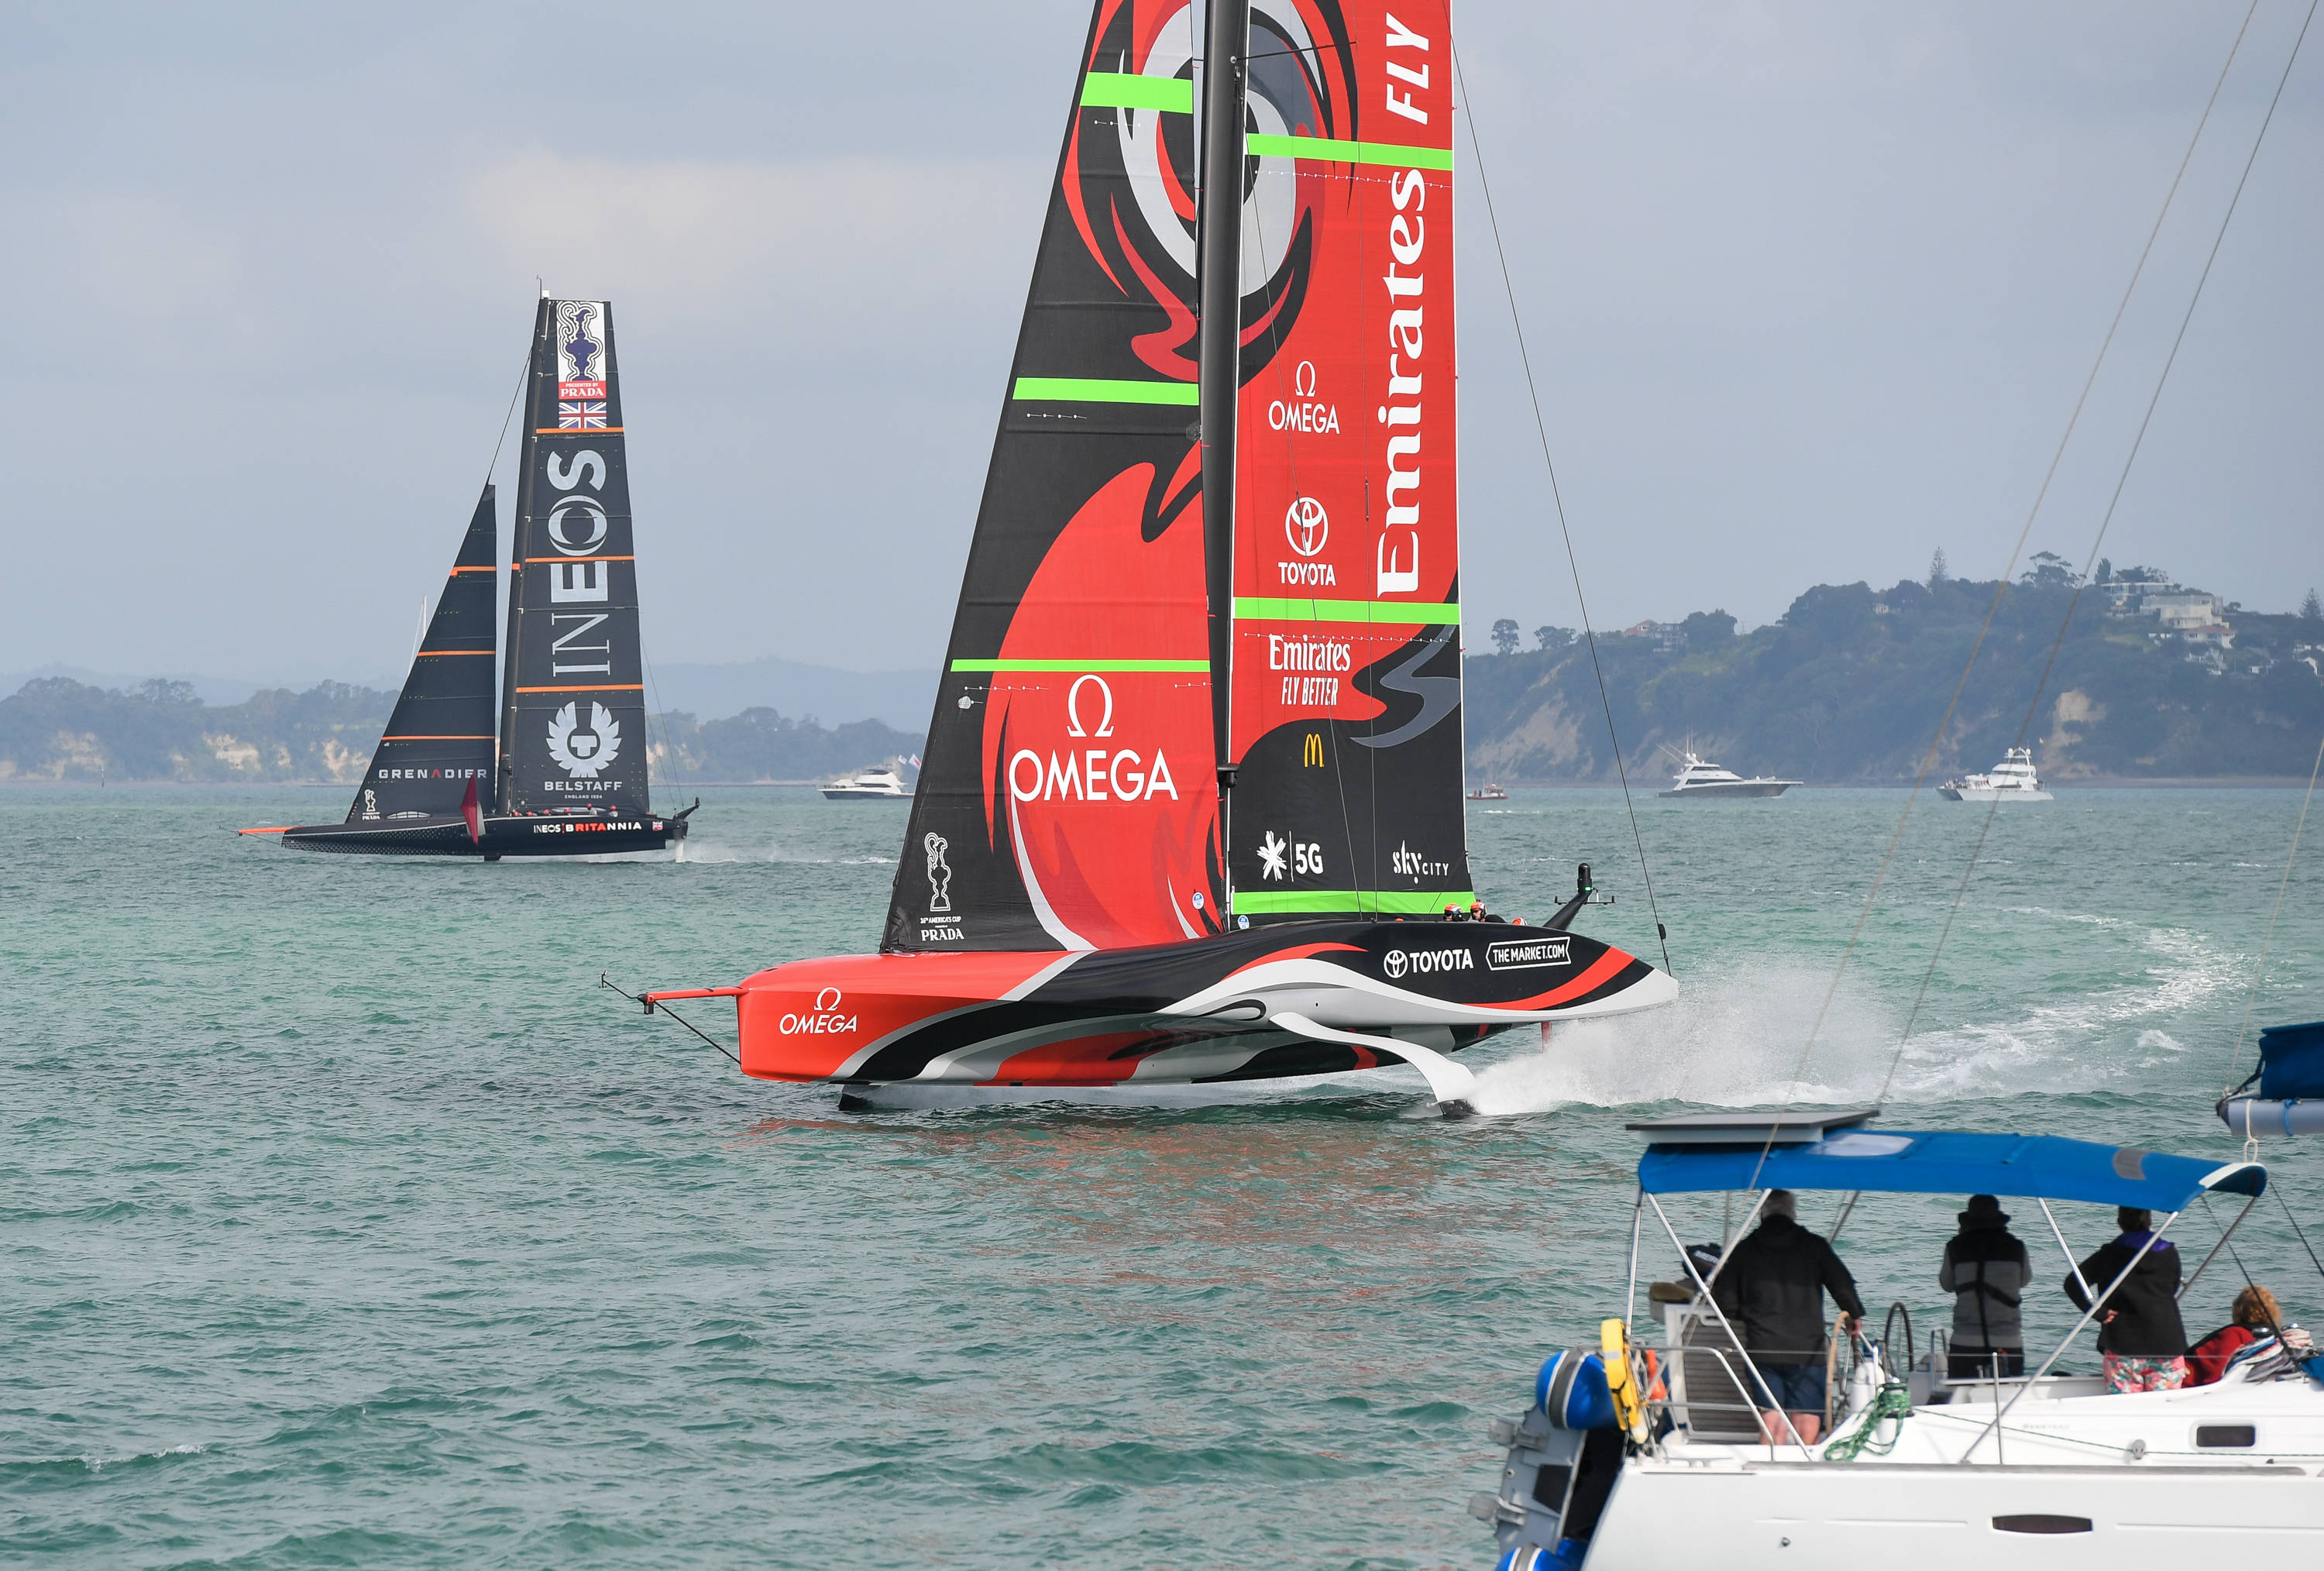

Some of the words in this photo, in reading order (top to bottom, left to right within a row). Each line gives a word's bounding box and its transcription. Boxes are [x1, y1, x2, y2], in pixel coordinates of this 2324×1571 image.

[1386, 12, 1429, 125] FLY
[561, 388, 603, 397] PRADA
[1377, 169, 1425, 598] Emirates
[1268, 400, 1340, 434] OMEGA
[547, 449, 610, 677] INEOS
[1278, 562, 1336, 586] TOYOTA
[1269, 634, 1351, 672] Emirates
[1281, 676, 1300, 705] FLY
[1301, 676, 1339, 706] BETTER
[378, 768, 487, 779] GRENADIER
[544, 781, 623, 791] BELSTAFF
[1009, 748, 1179, 802] OMEGA
[533, 823, 561, 834] INEOS
[566, 822, 642, 833] BRITANNIA
[1295, 843, 1324, 875] 5G
[920, 928, 965, 941] PRADA
[1409, 949, 1474, 973] TOYOTA
[779, 1013, 858, 1035] OMEGA
